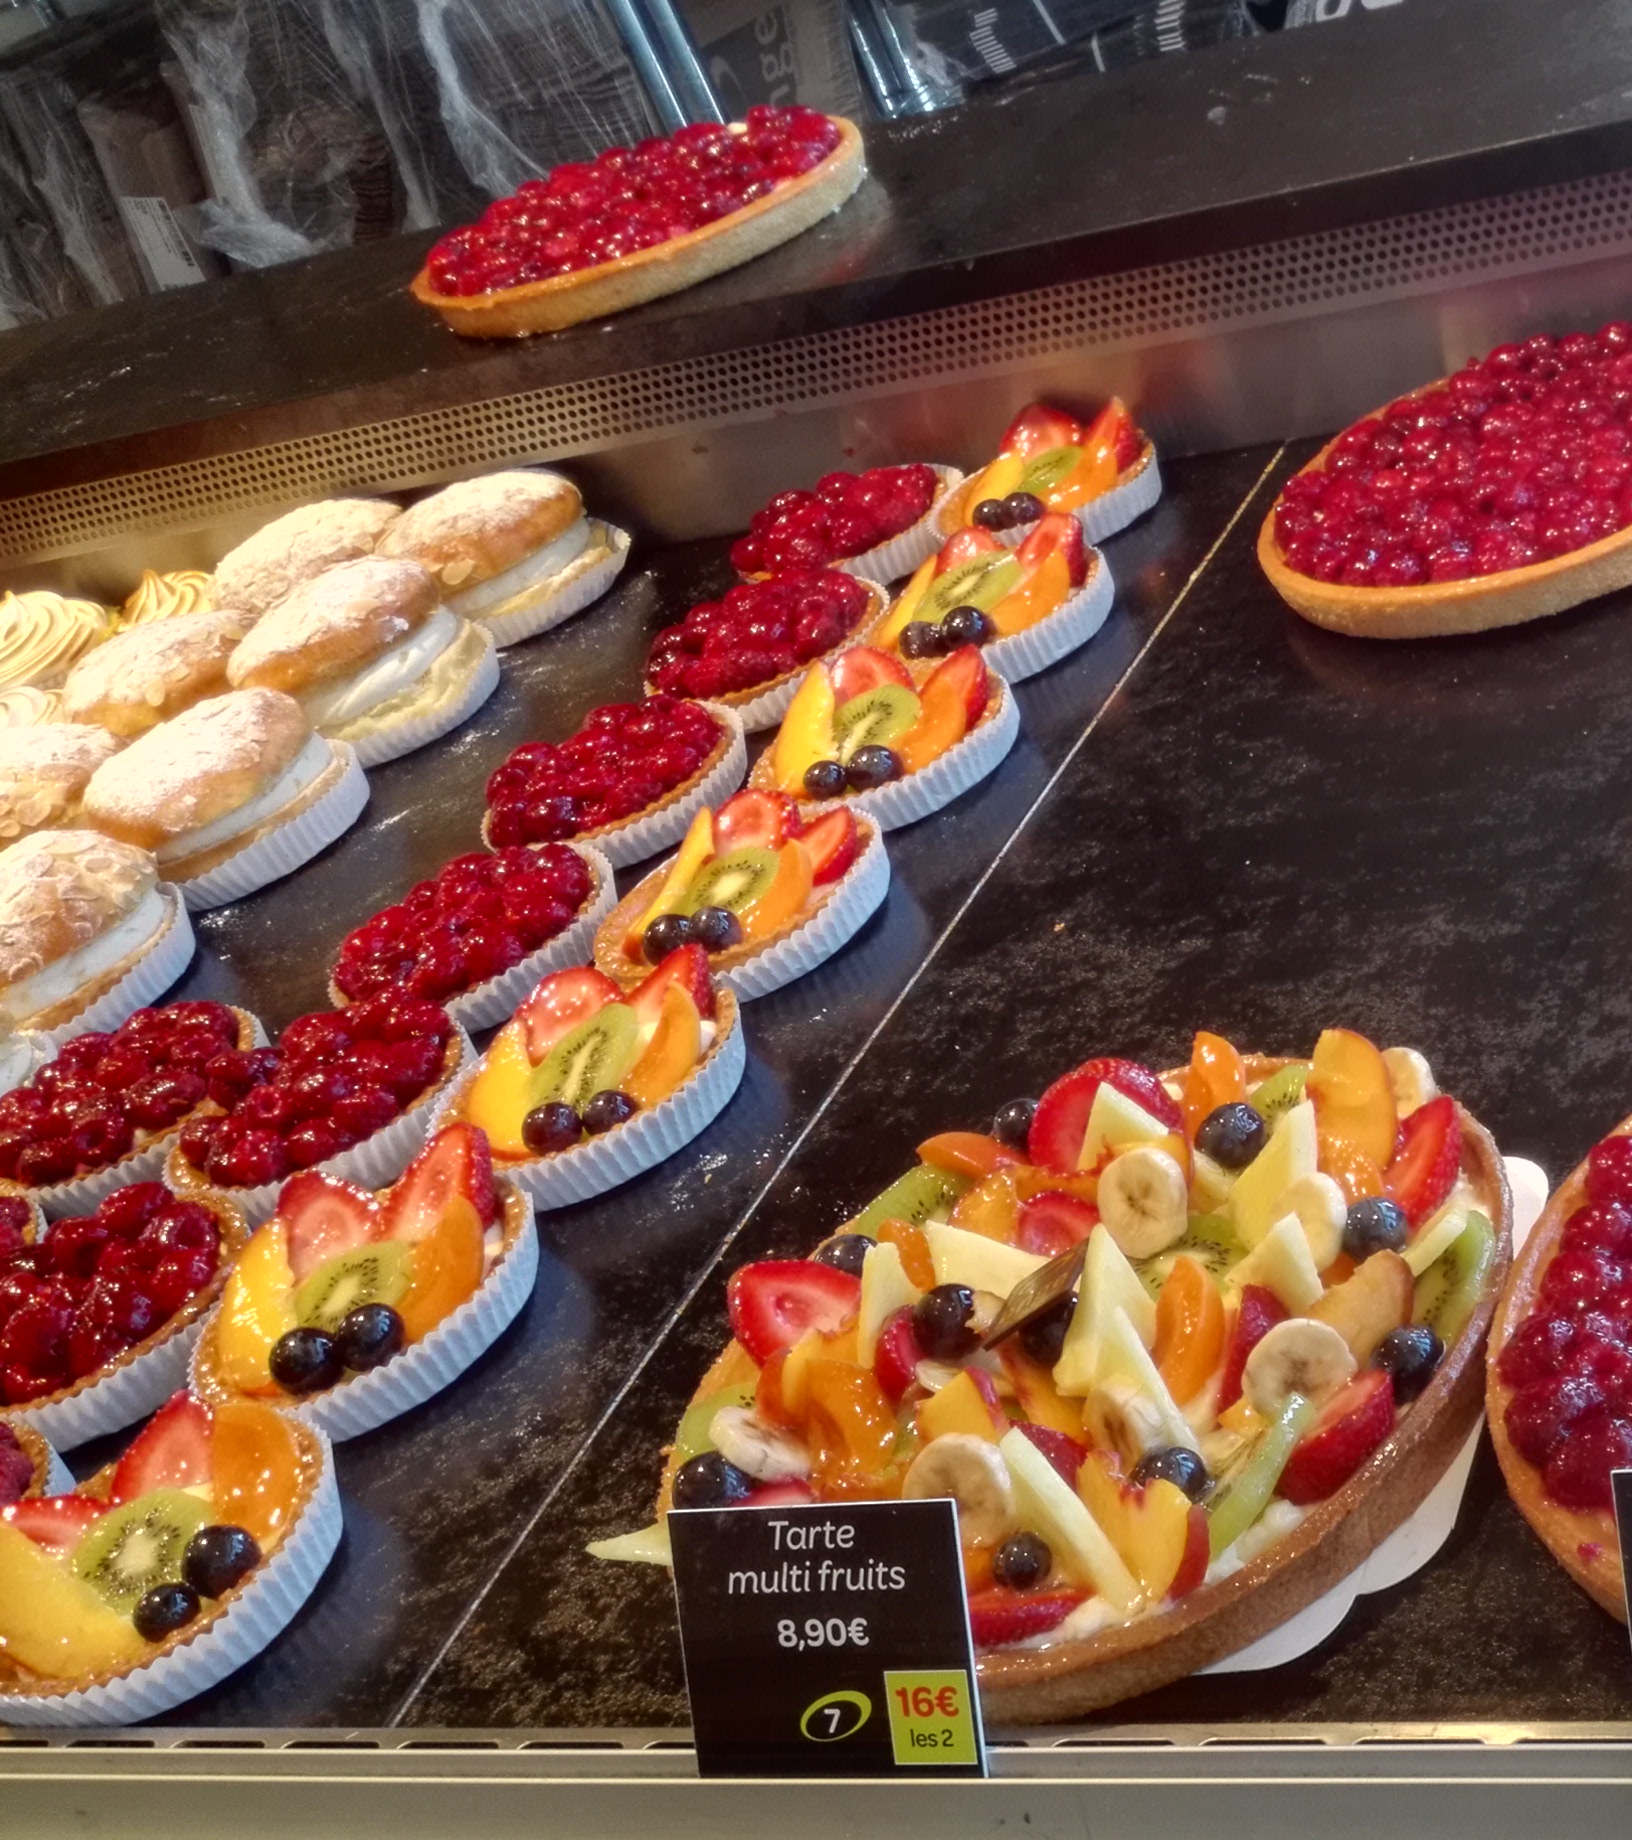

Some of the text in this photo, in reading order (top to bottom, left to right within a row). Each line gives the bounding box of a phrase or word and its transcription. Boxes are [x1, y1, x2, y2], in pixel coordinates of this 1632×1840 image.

[768, 1520, 855, 1551] Tarte
[728, 1558, 906, 1595] multi fruits
[777, 1617, 870, 1652] 8,90€
[895, 1686, 960, 1717] 16€
[823, 1708, 842, 1734] 7
[910, 1728, 954, 1747] les 2
